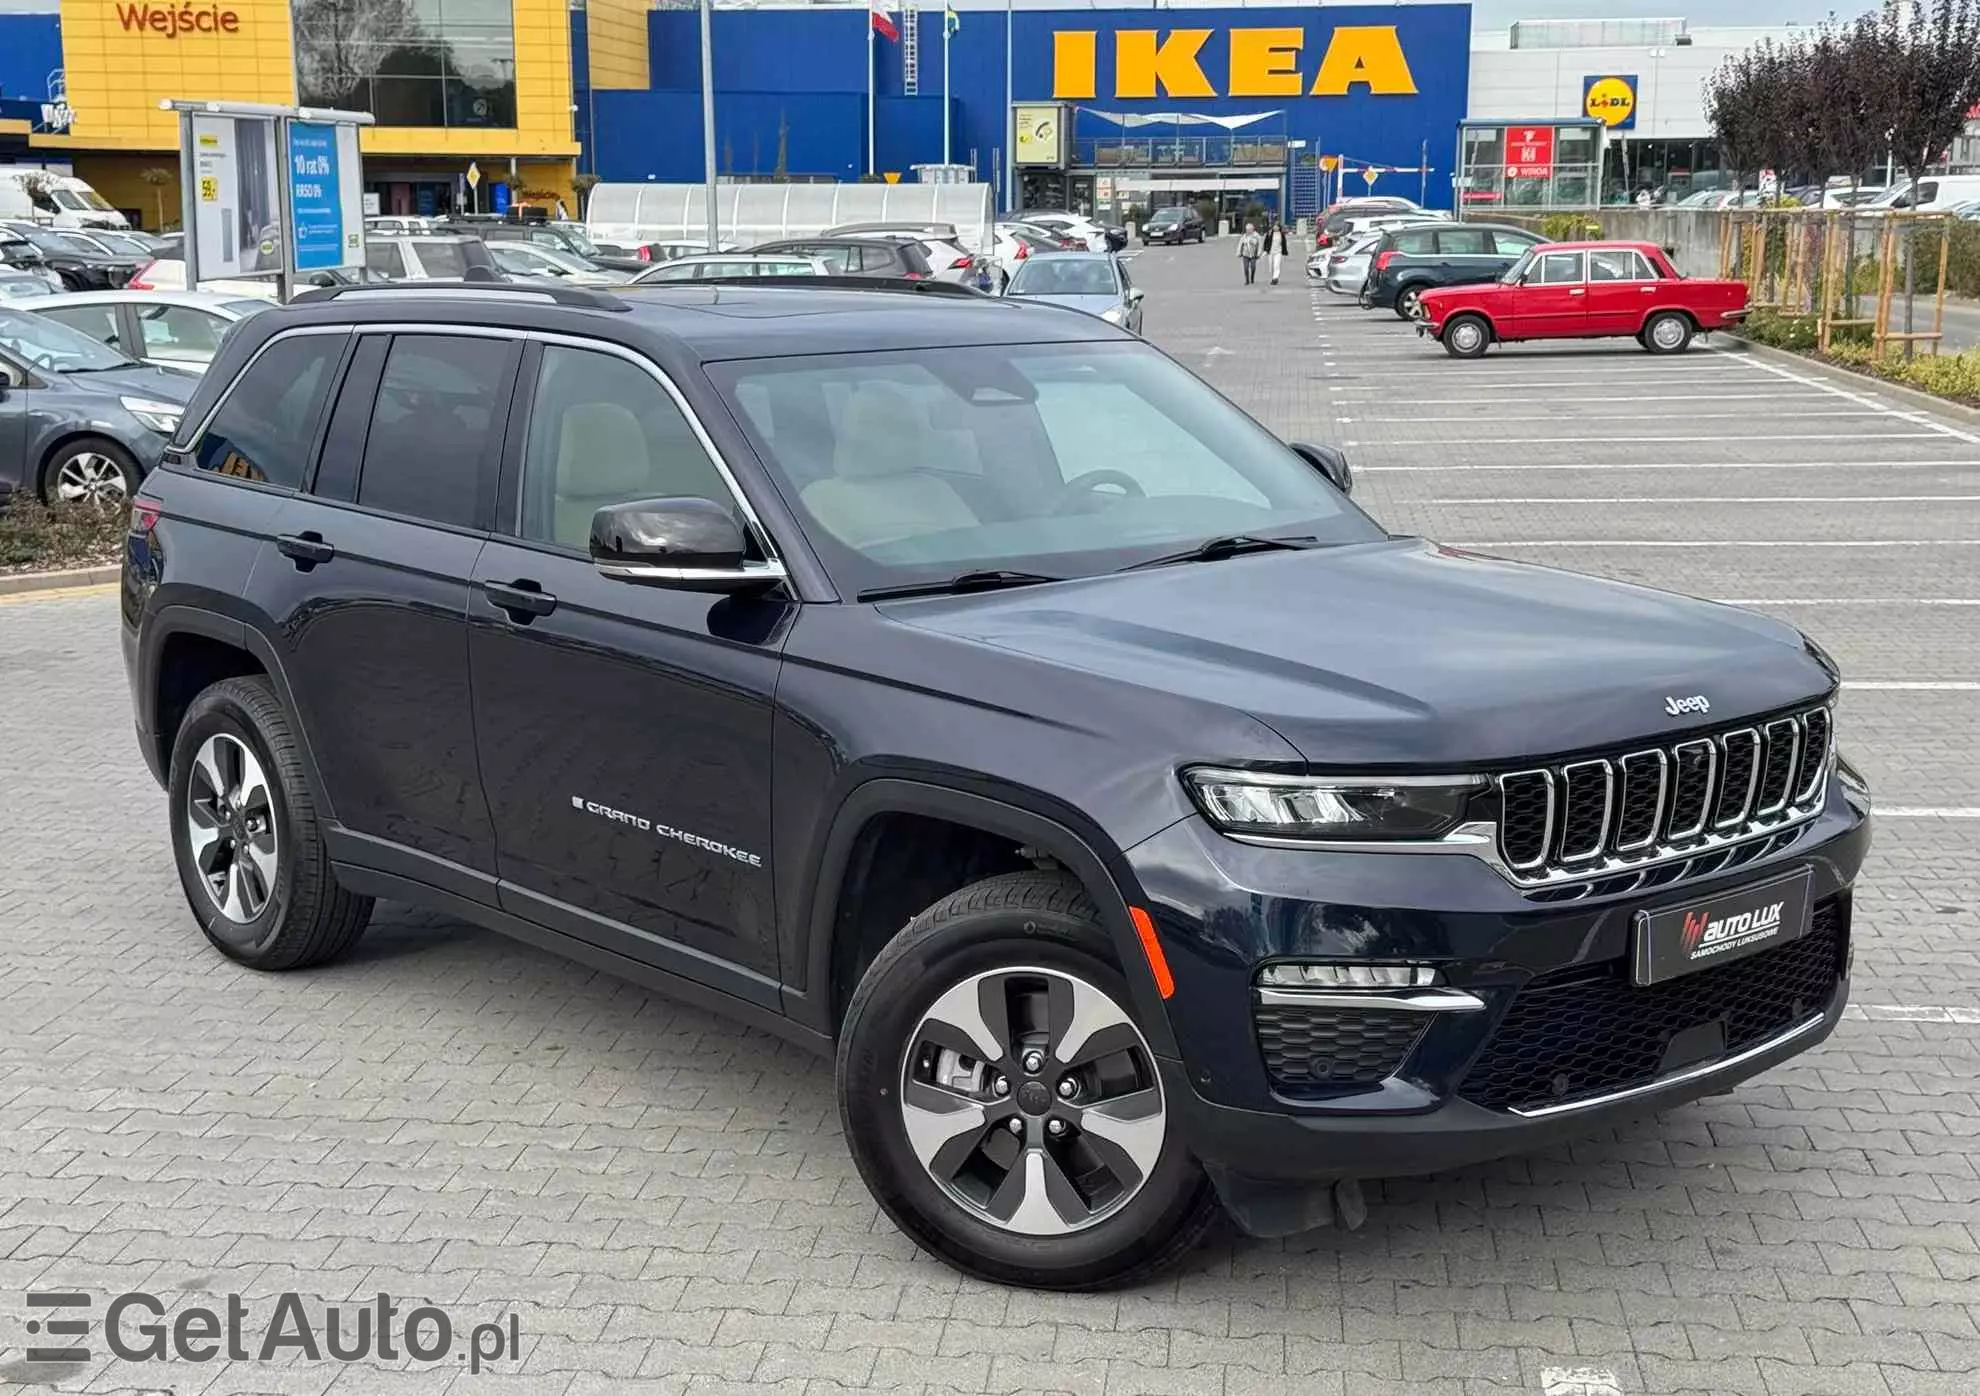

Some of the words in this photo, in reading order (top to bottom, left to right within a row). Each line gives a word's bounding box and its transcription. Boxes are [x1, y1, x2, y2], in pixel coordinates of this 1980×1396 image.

[116, 2, 240, 38] Wejście
[1052, 25, 1419, 98] IKEA
[1665, 693, 1710, 716] Jeep
[586, 801, 651, 831] GRAND
[656, 824, 762, 868] CHEROKEE
[1752, 901, 1785, 928] LUX
